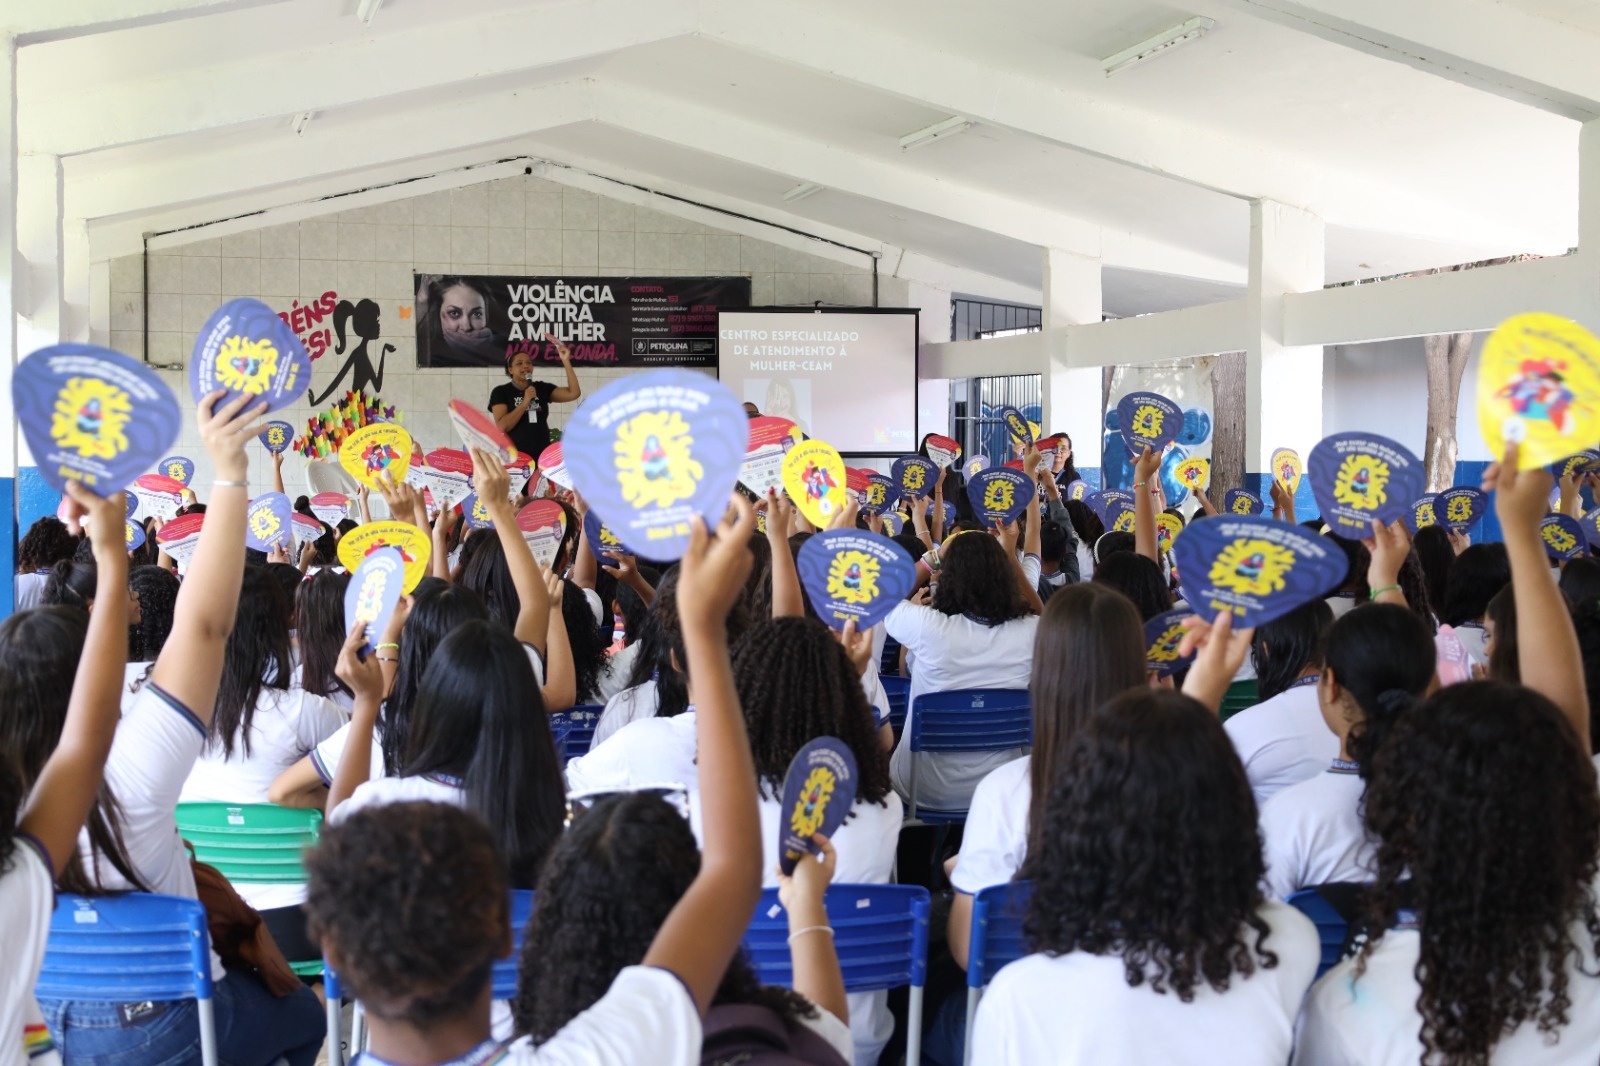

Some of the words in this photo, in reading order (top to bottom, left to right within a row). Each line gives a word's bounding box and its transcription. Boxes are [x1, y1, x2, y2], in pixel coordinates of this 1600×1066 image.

[507, 280, 615, 303] VIOLÊNCIA
[508, 303, 594, 322] CONTRA
[508, 323, 524, 341] A
[527, 323, 606, 341] MULHER
[720, 330, 768, 340] CENTRO
[772, 331, 859, 342] ESPECIALIZADO
[505, 339, 540, 361] NÃO
[650, 343, 688, 352] PETROLINA
[734, 345, 749, 356] DE
[752, 346, 836, 356] ATENDIMENTO
[750, 361, 833, 371] MULHER-CEAM
